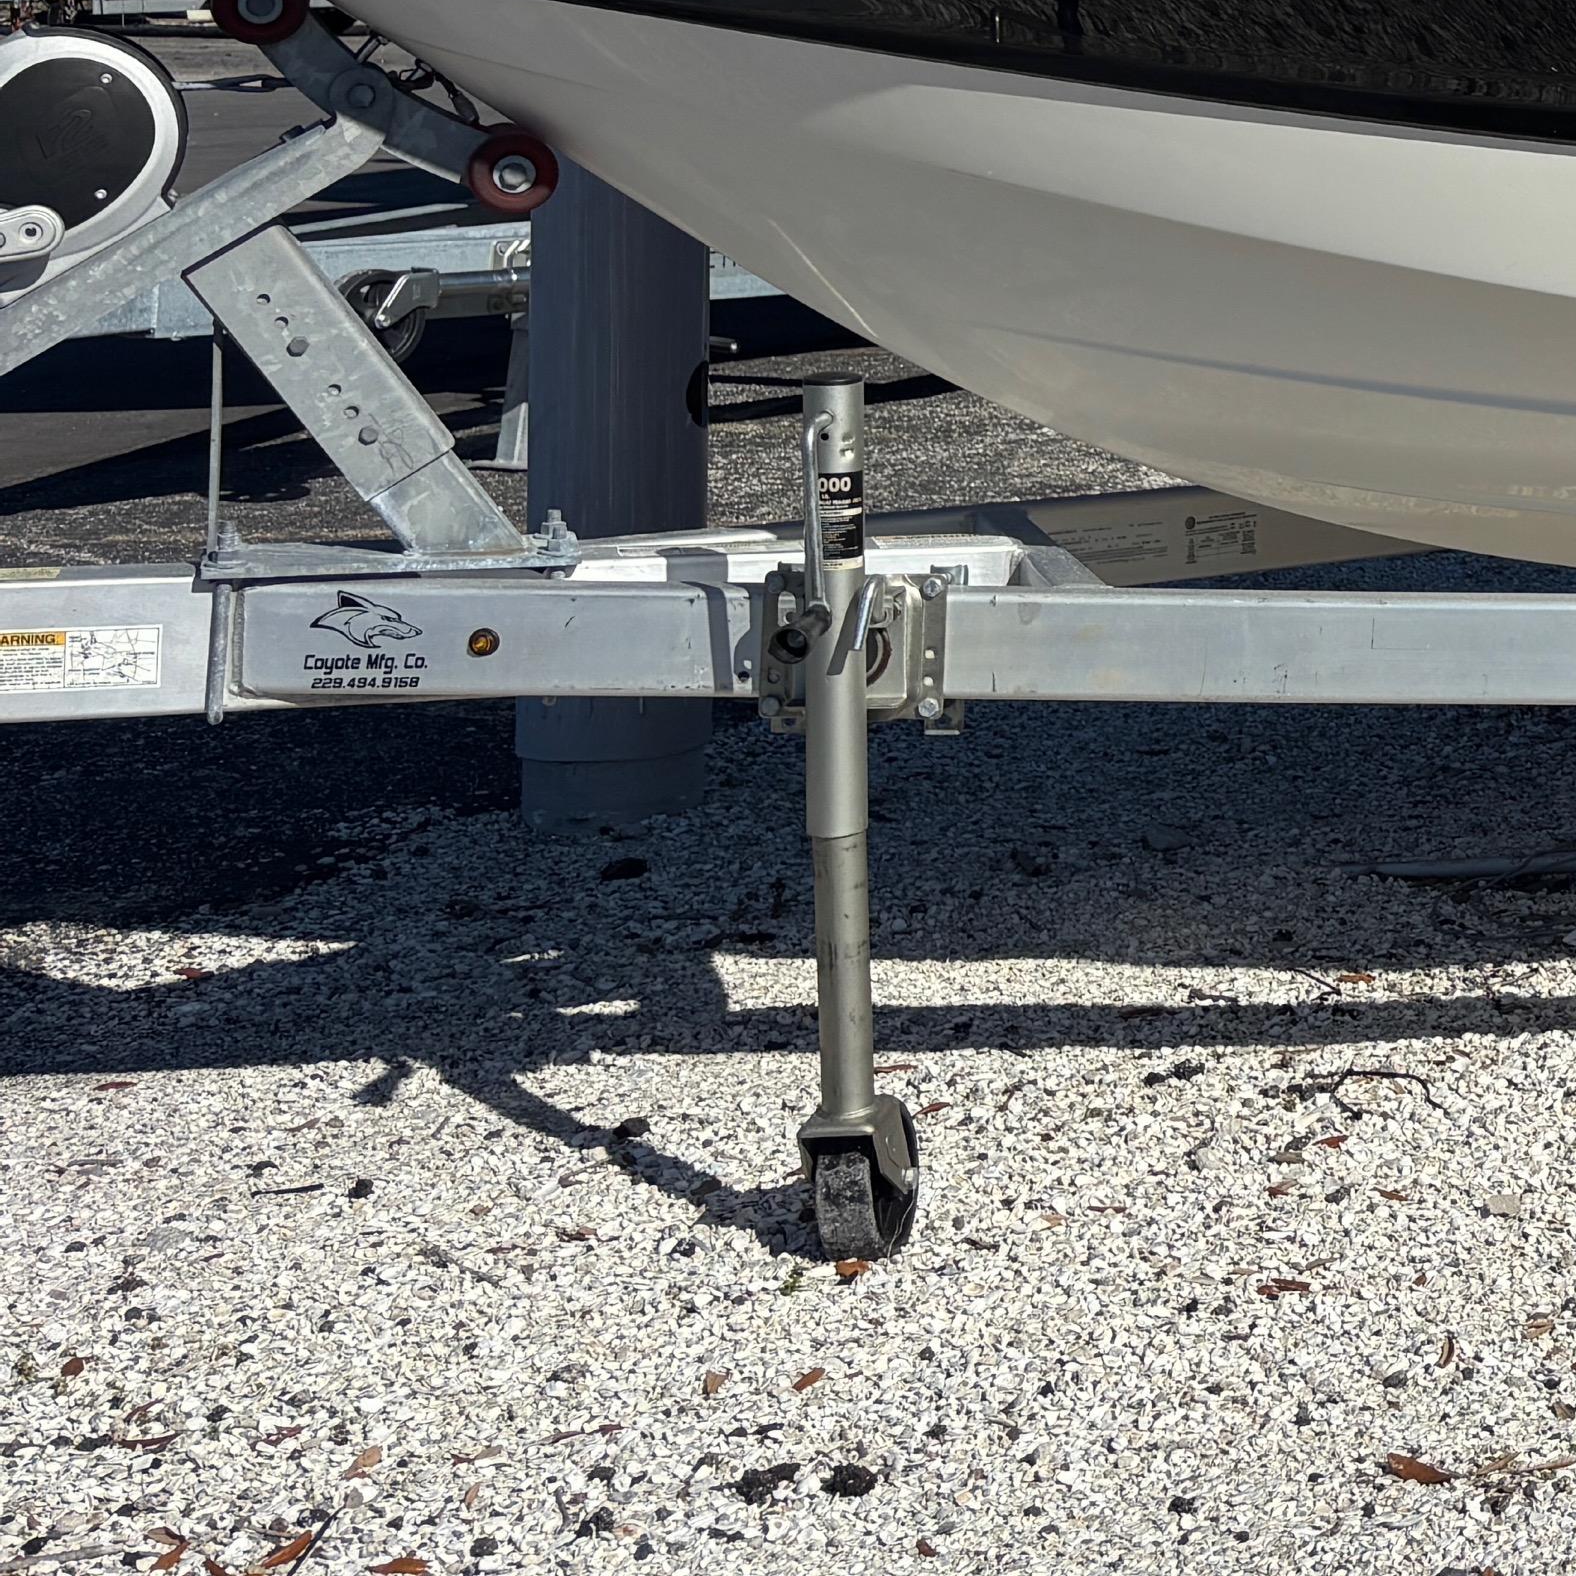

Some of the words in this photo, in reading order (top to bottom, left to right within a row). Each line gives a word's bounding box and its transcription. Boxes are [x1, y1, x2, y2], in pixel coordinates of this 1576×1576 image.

[817, 476, 852, 493] 000
[0, 633, 56, 646] ARNING
[303, 653, 362, 675] Coyote
[366, 653, 398, 675] Mfg.
[403, 653, 429, 669] Co.
[310, 676, 421, 689] 229.494.9158
